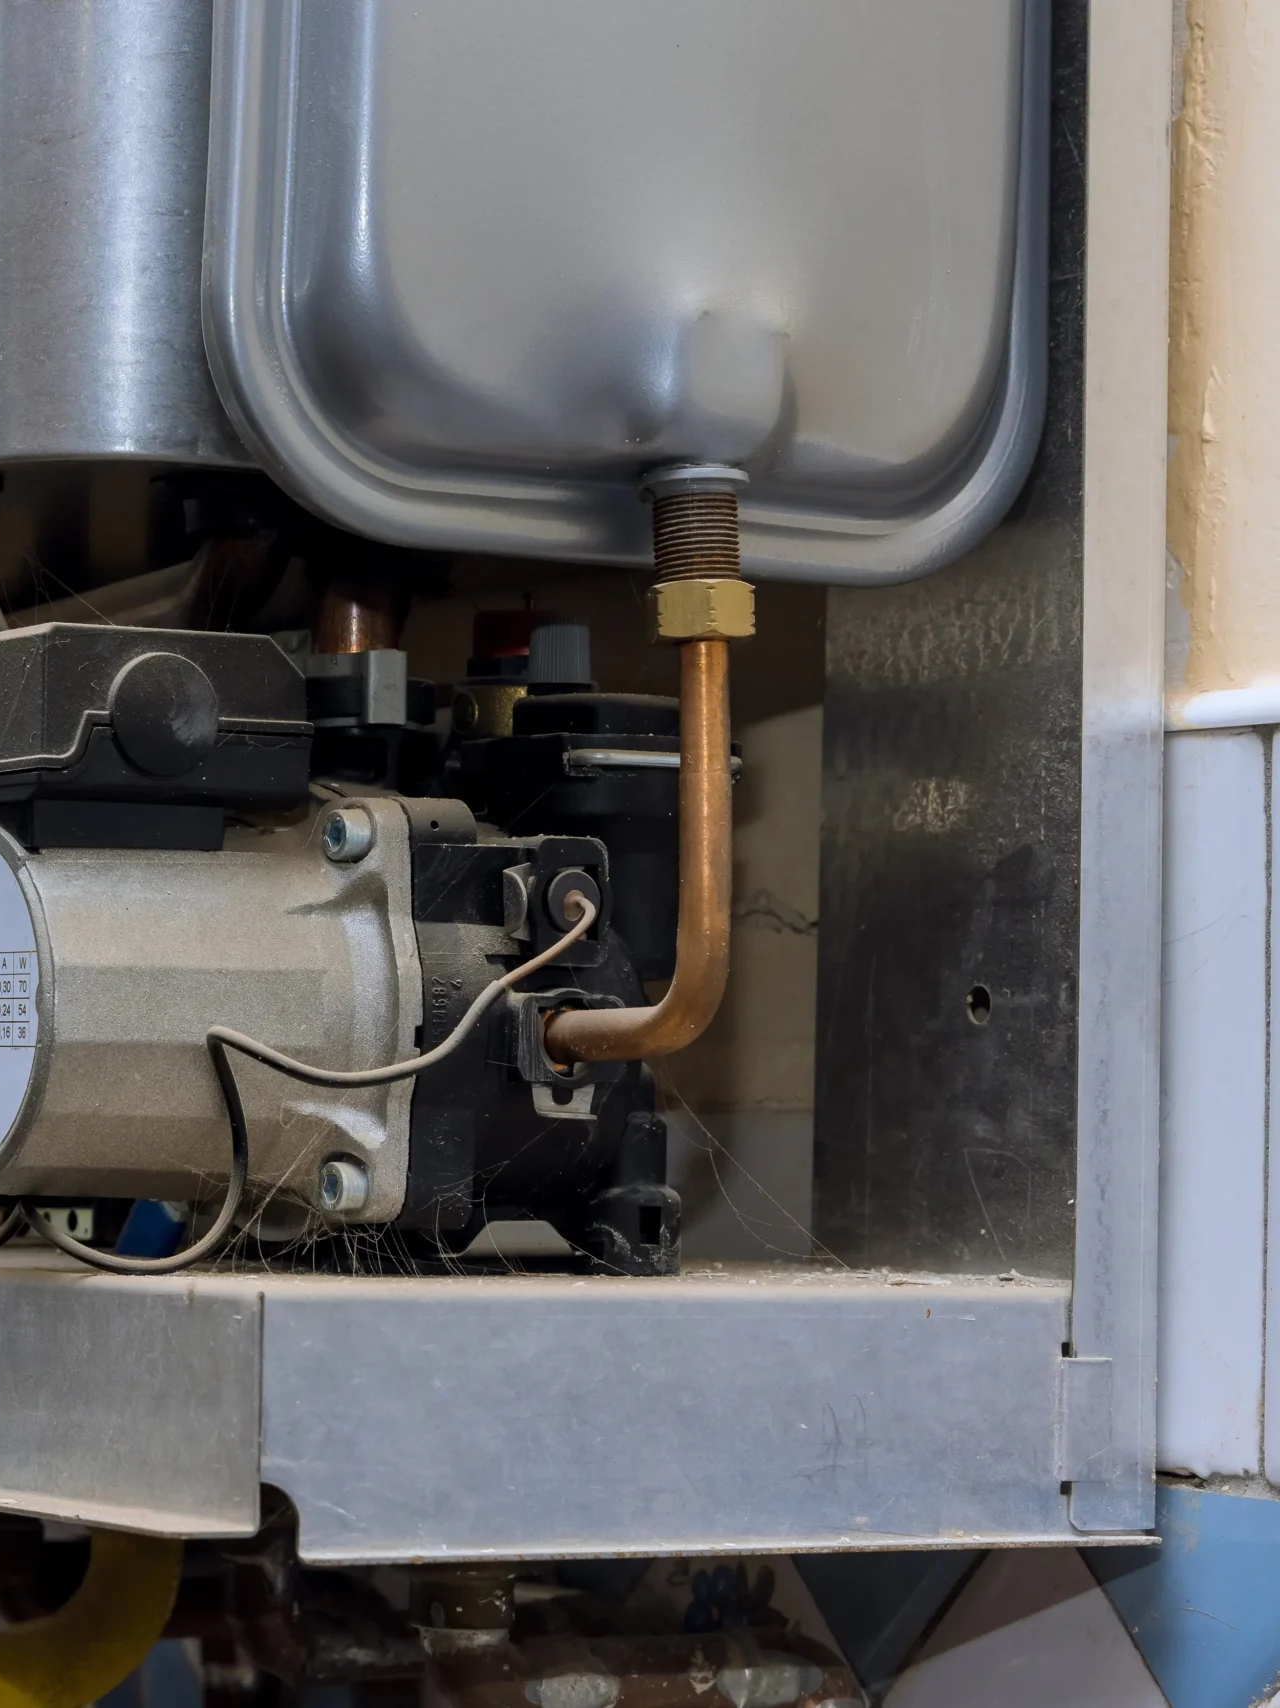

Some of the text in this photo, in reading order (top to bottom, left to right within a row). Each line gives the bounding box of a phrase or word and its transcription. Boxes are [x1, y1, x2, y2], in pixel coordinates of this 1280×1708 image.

[1, 958, 8, 970] A
[18, 957, 27, 969] W
[18, 981, 27, 993] 70
[18, 1004, 27, 1016] 54
